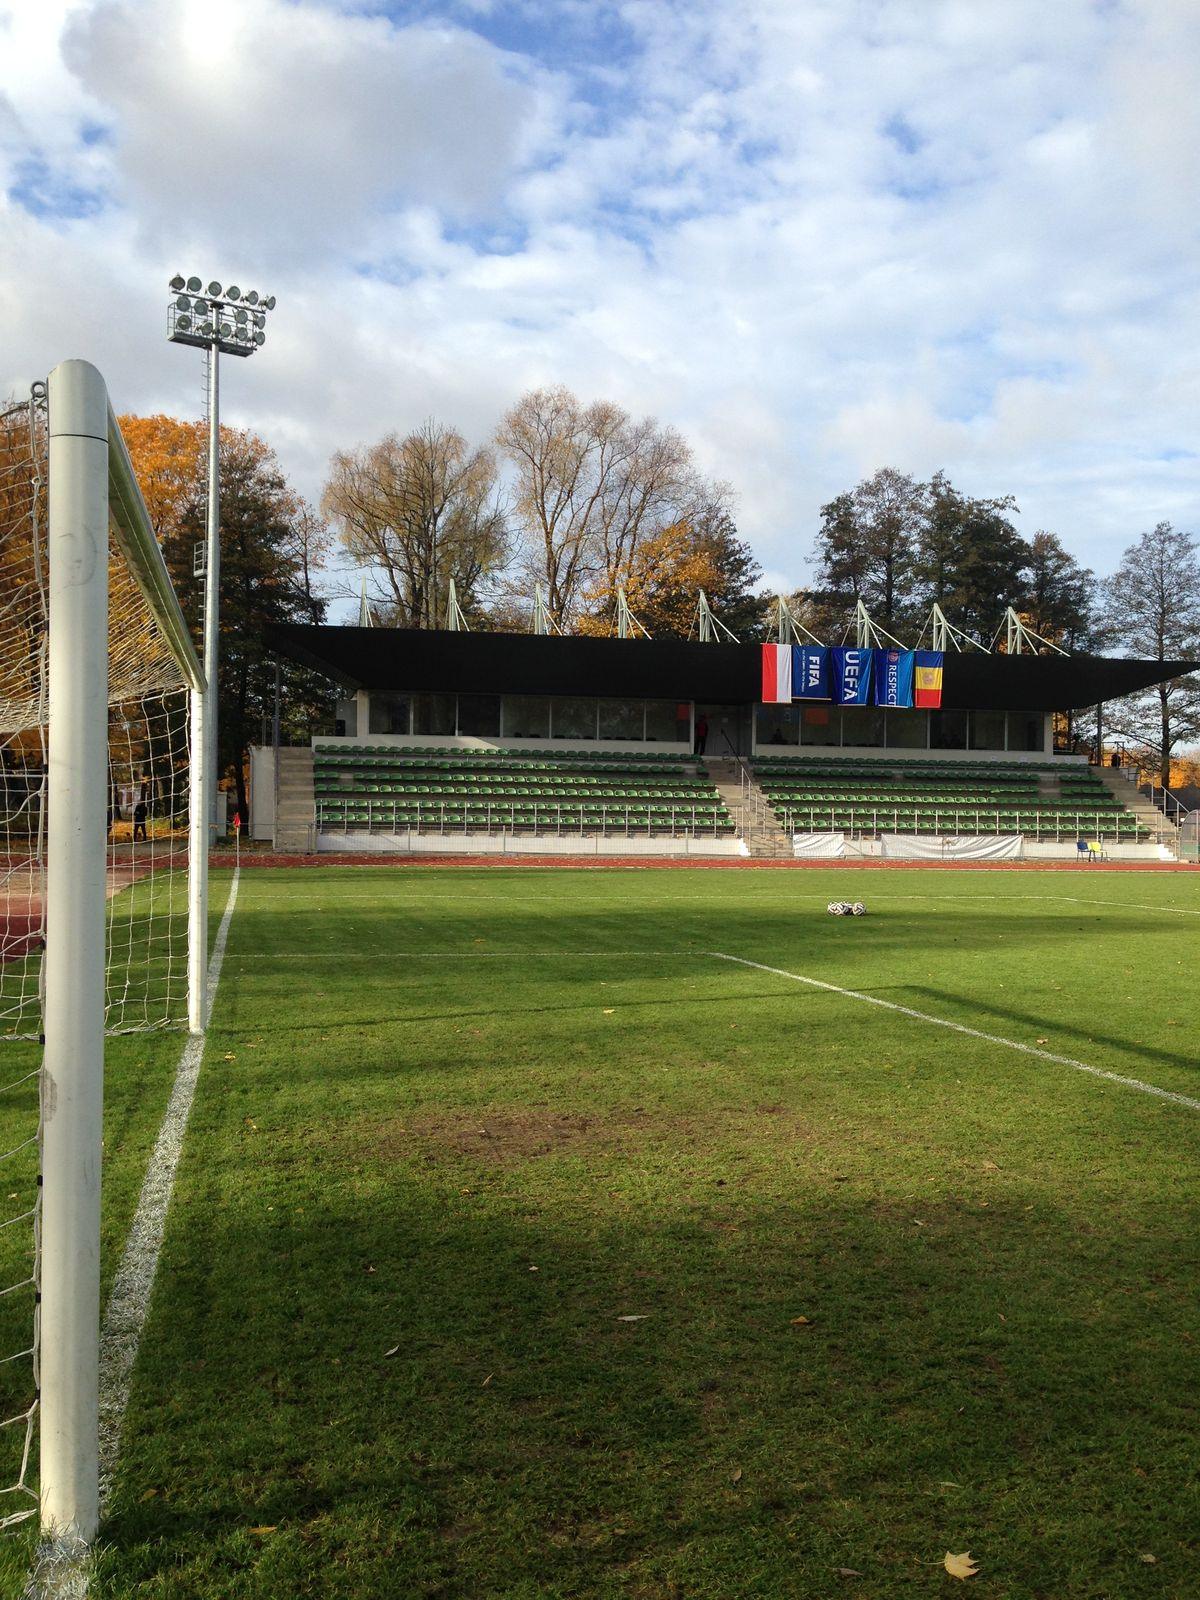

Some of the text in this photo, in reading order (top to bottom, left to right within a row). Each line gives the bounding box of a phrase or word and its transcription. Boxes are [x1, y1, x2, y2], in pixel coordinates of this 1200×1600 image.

[808, 656, 820, 687] FIFA
[844, 651, 860, 700] UEFA
[888, 664, 897, 706] RESPECT
